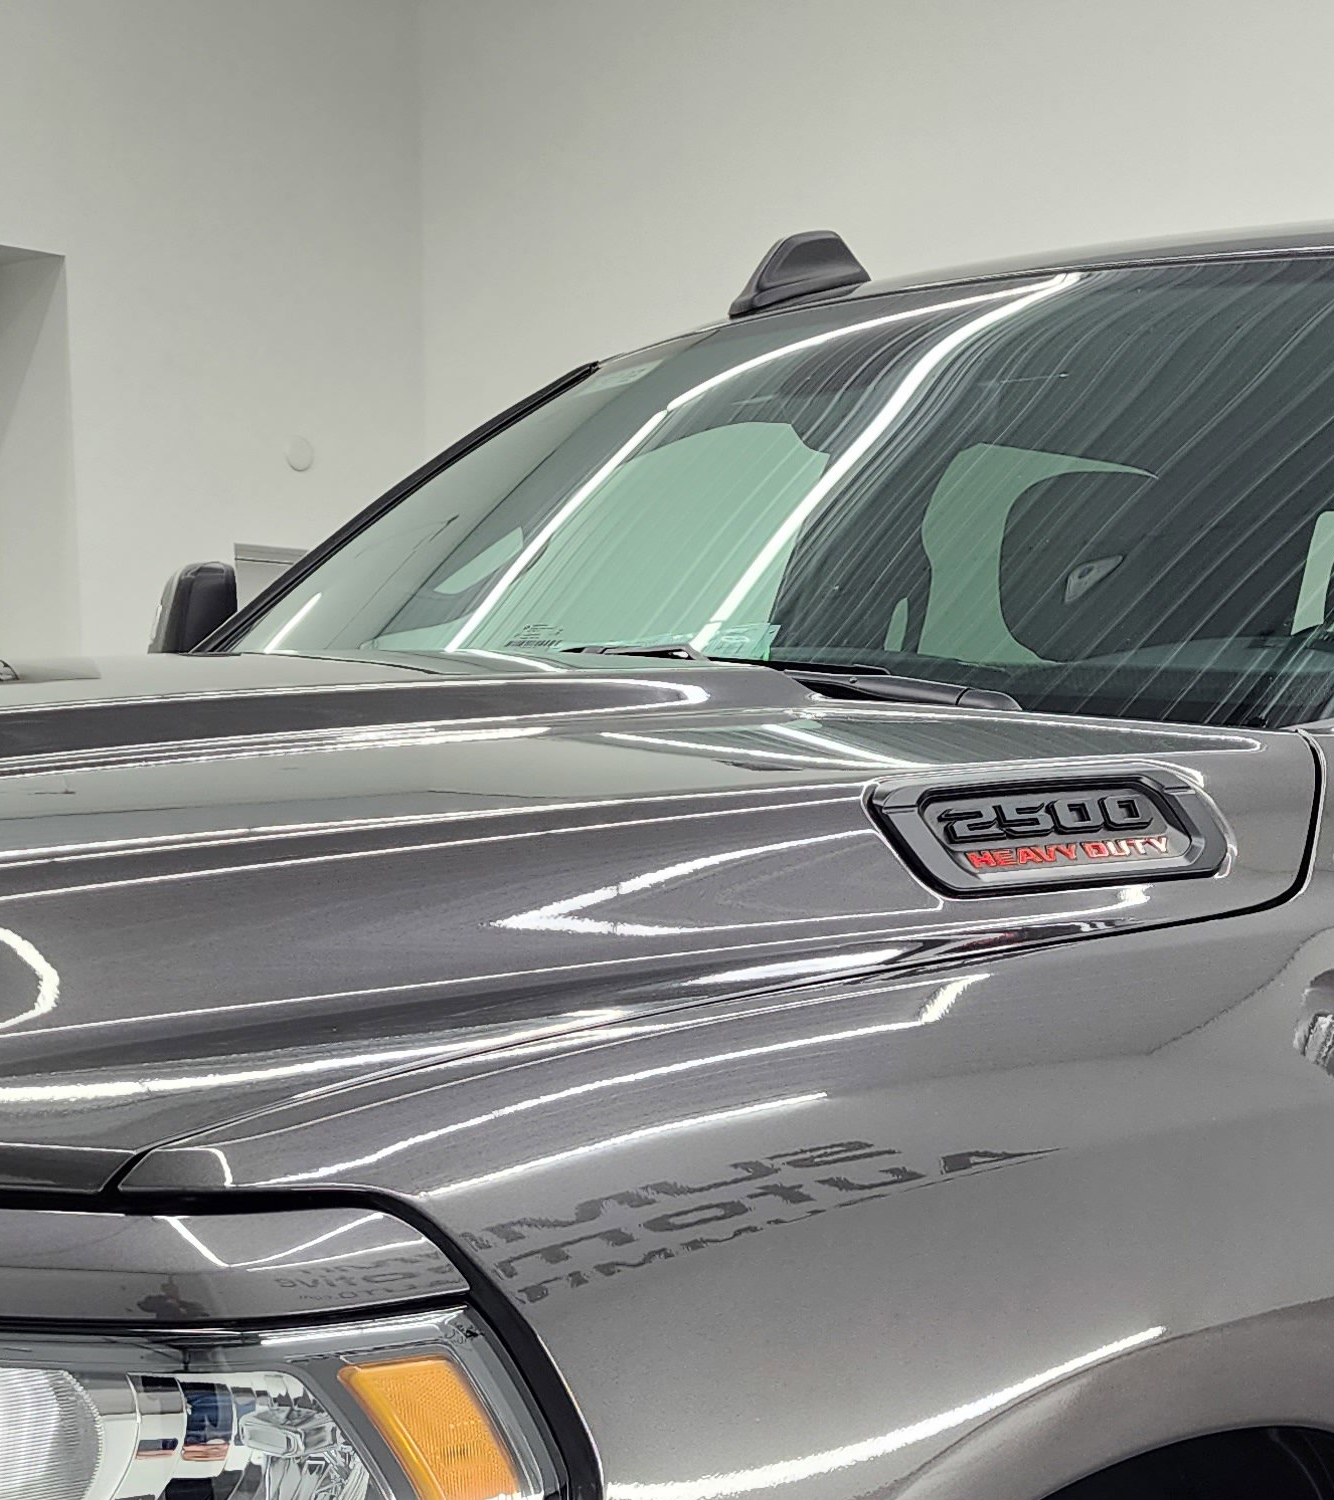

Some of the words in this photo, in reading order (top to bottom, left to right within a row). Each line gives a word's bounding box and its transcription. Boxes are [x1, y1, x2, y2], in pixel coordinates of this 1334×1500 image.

[938, 796, 1153, 844] 2500
[966, 842, 1078, 869] HEAVY
[1079, 836, 1170, 860] DUTY
